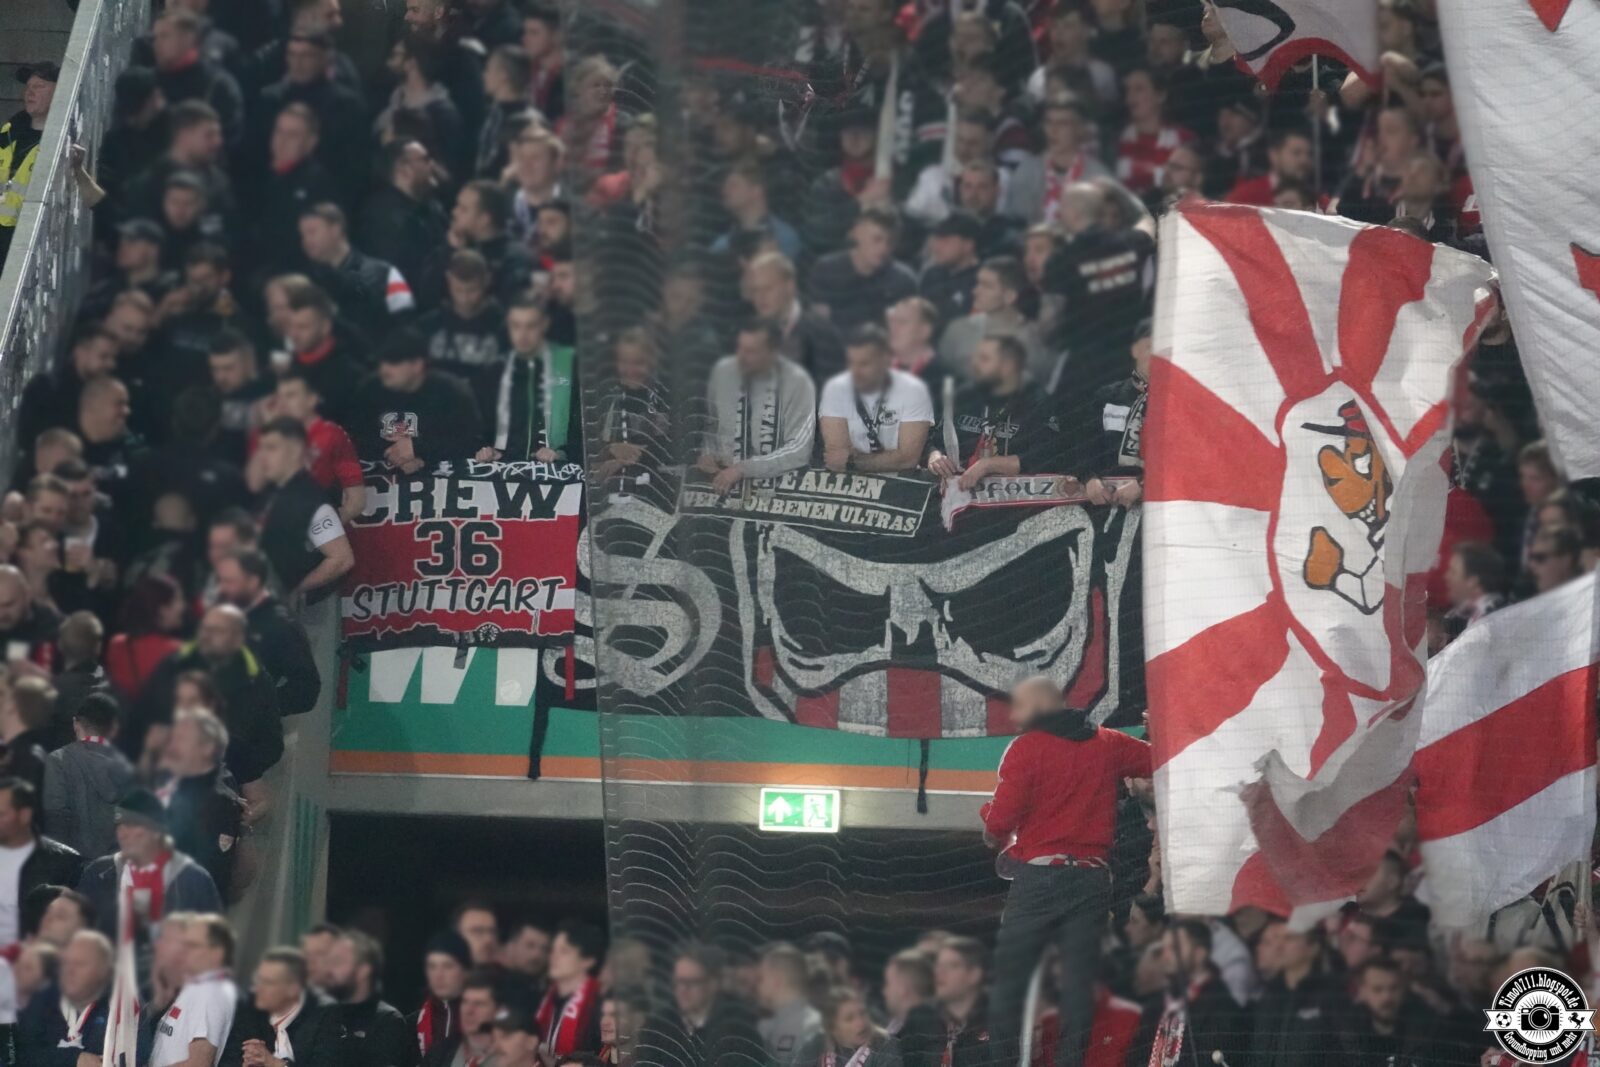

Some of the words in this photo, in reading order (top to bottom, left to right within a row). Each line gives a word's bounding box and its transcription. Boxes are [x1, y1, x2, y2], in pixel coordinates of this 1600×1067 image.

[350, 475, 566, 528] CREW
[799, 471, 887, 500] ALLEN
[682, 490, 838, 521] VERORBENEN
[839, 503, 918, 533] ULTRAS
[413, 519, 503, 578] 36
[351, 576, 567, 623] STUTTGART
